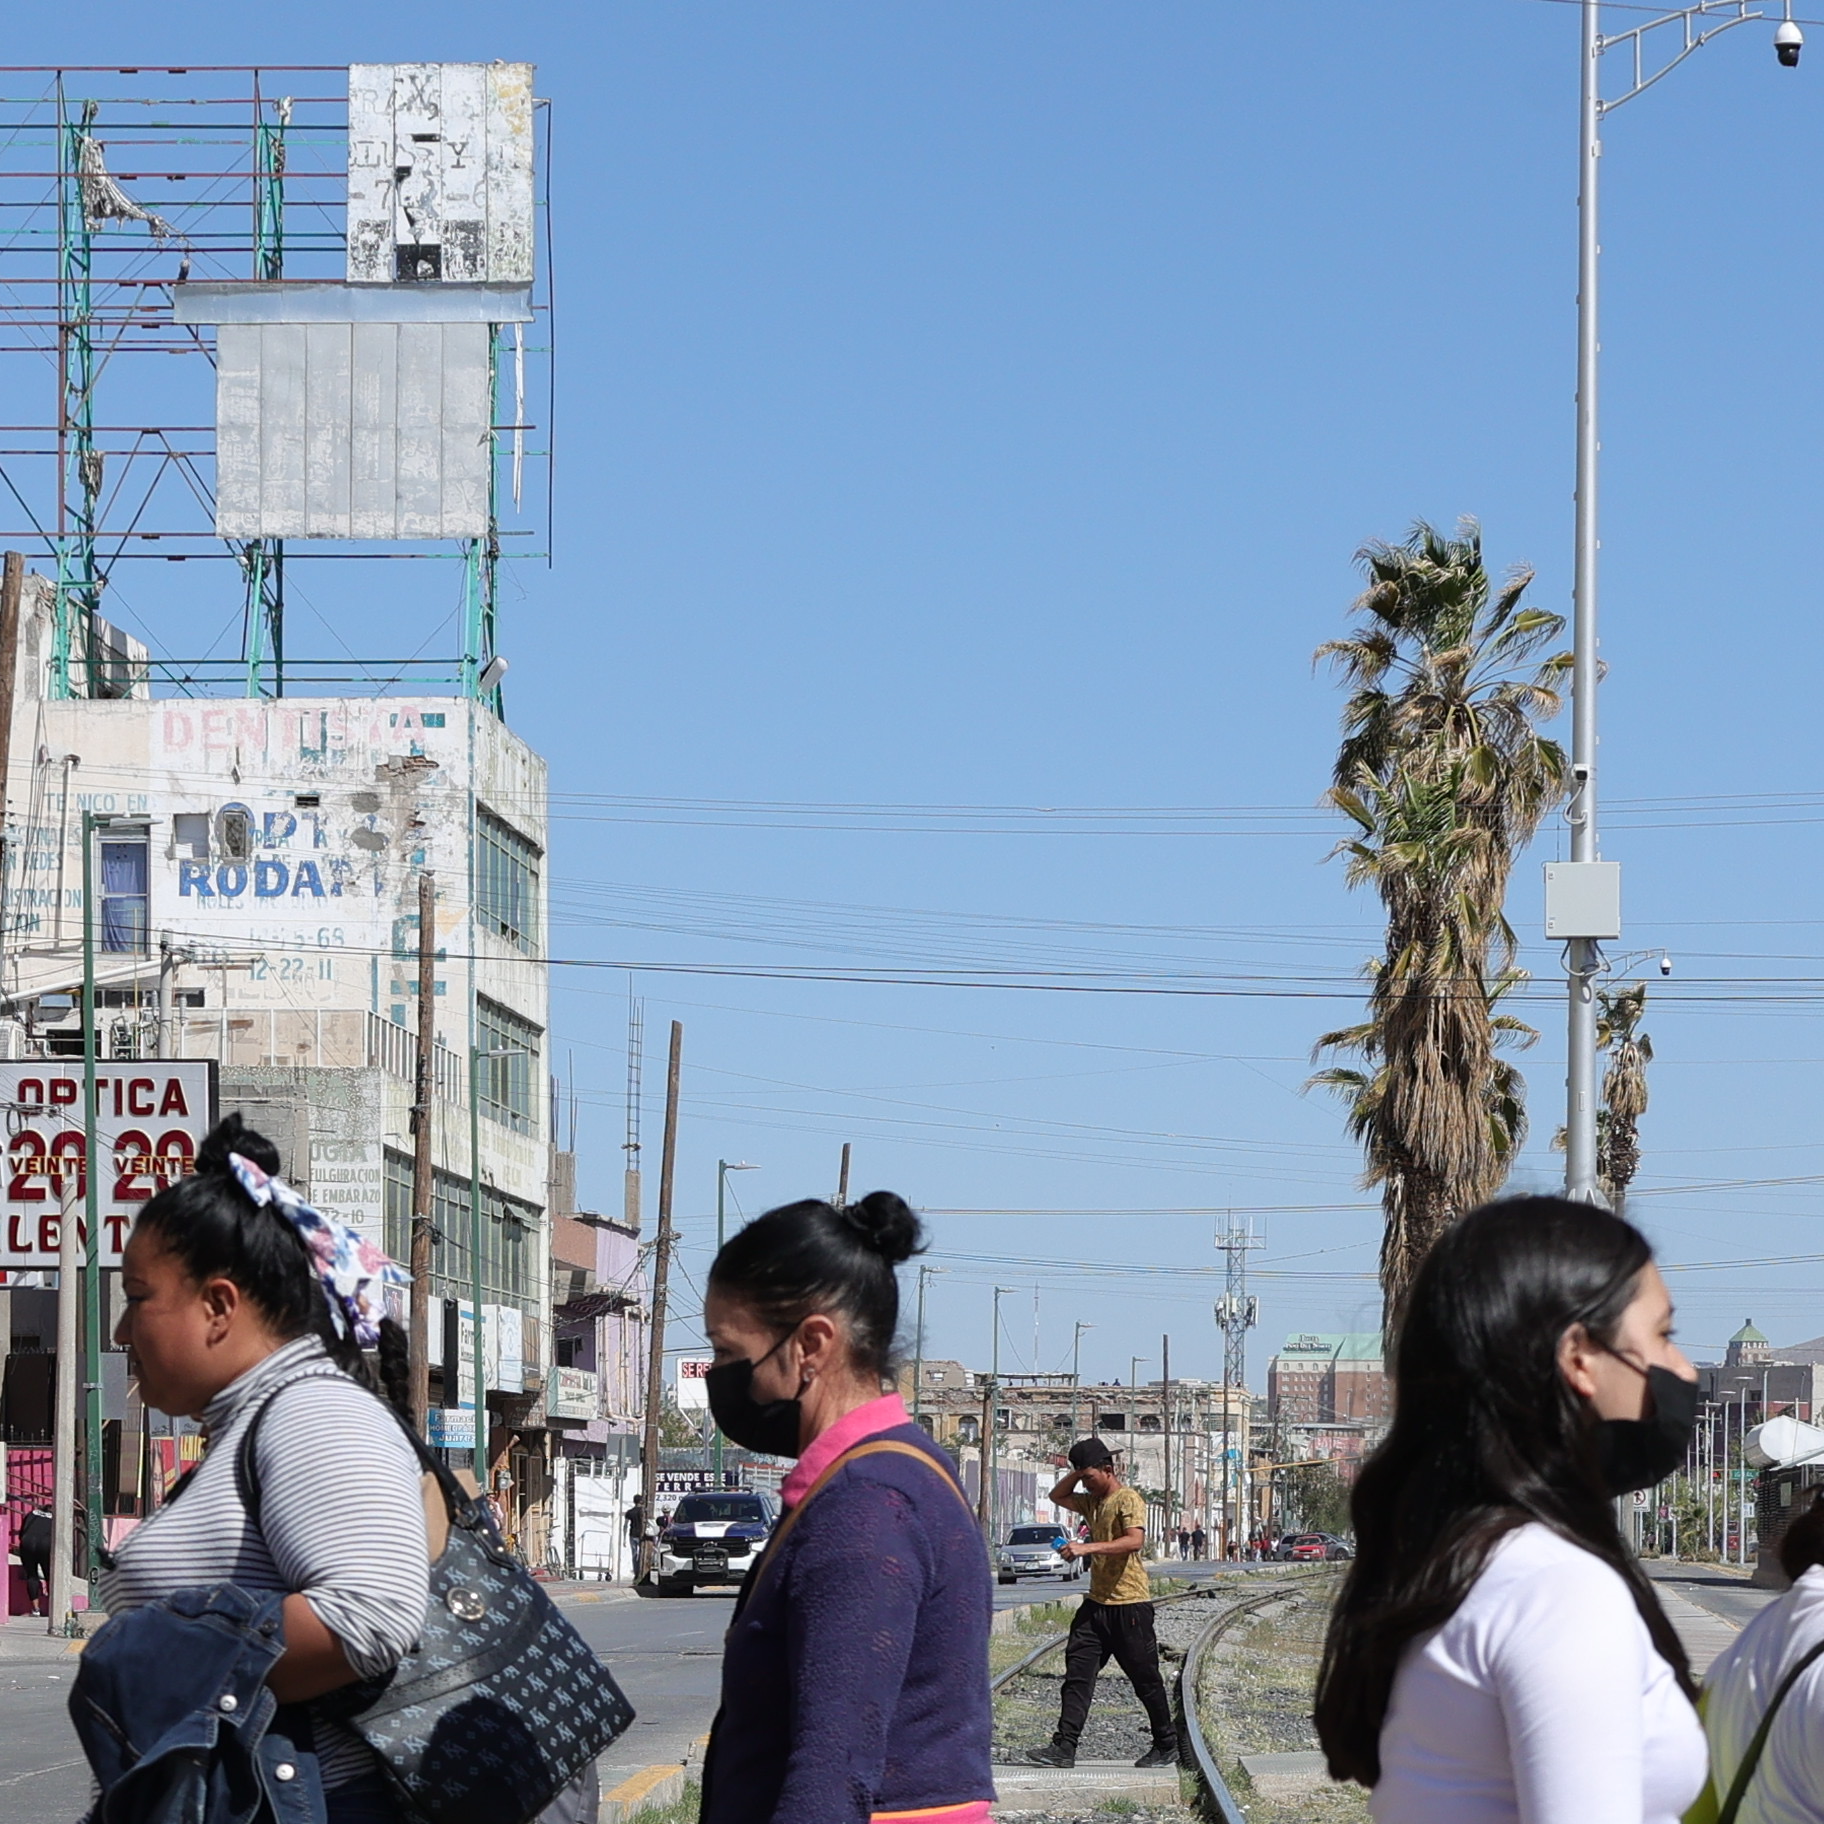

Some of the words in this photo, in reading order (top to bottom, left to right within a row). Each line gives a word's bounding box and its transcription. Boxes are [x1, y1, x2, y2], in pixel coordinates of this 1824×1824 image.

[162, 705, 425, 752] DENTISTA
[127, 793, 148, 812] EN
[18, 1078, 190, 1117] OPTICA
[8, 1130, 87, 1201] 20
[113, 1130, 195, 1201] 20
[9, 1157, 87, 1175] VEINTE
[114, 1157, 195, 1175] VEINTE
[322, 1188, 381, 1203] EMBARAZO
[682, 1362, 697, 1378] SE
[655, 1473, 666, 1482] SE
[666, 1473, 700, 1482] VENDE
[704, 1473, 726, 1482] ESE
